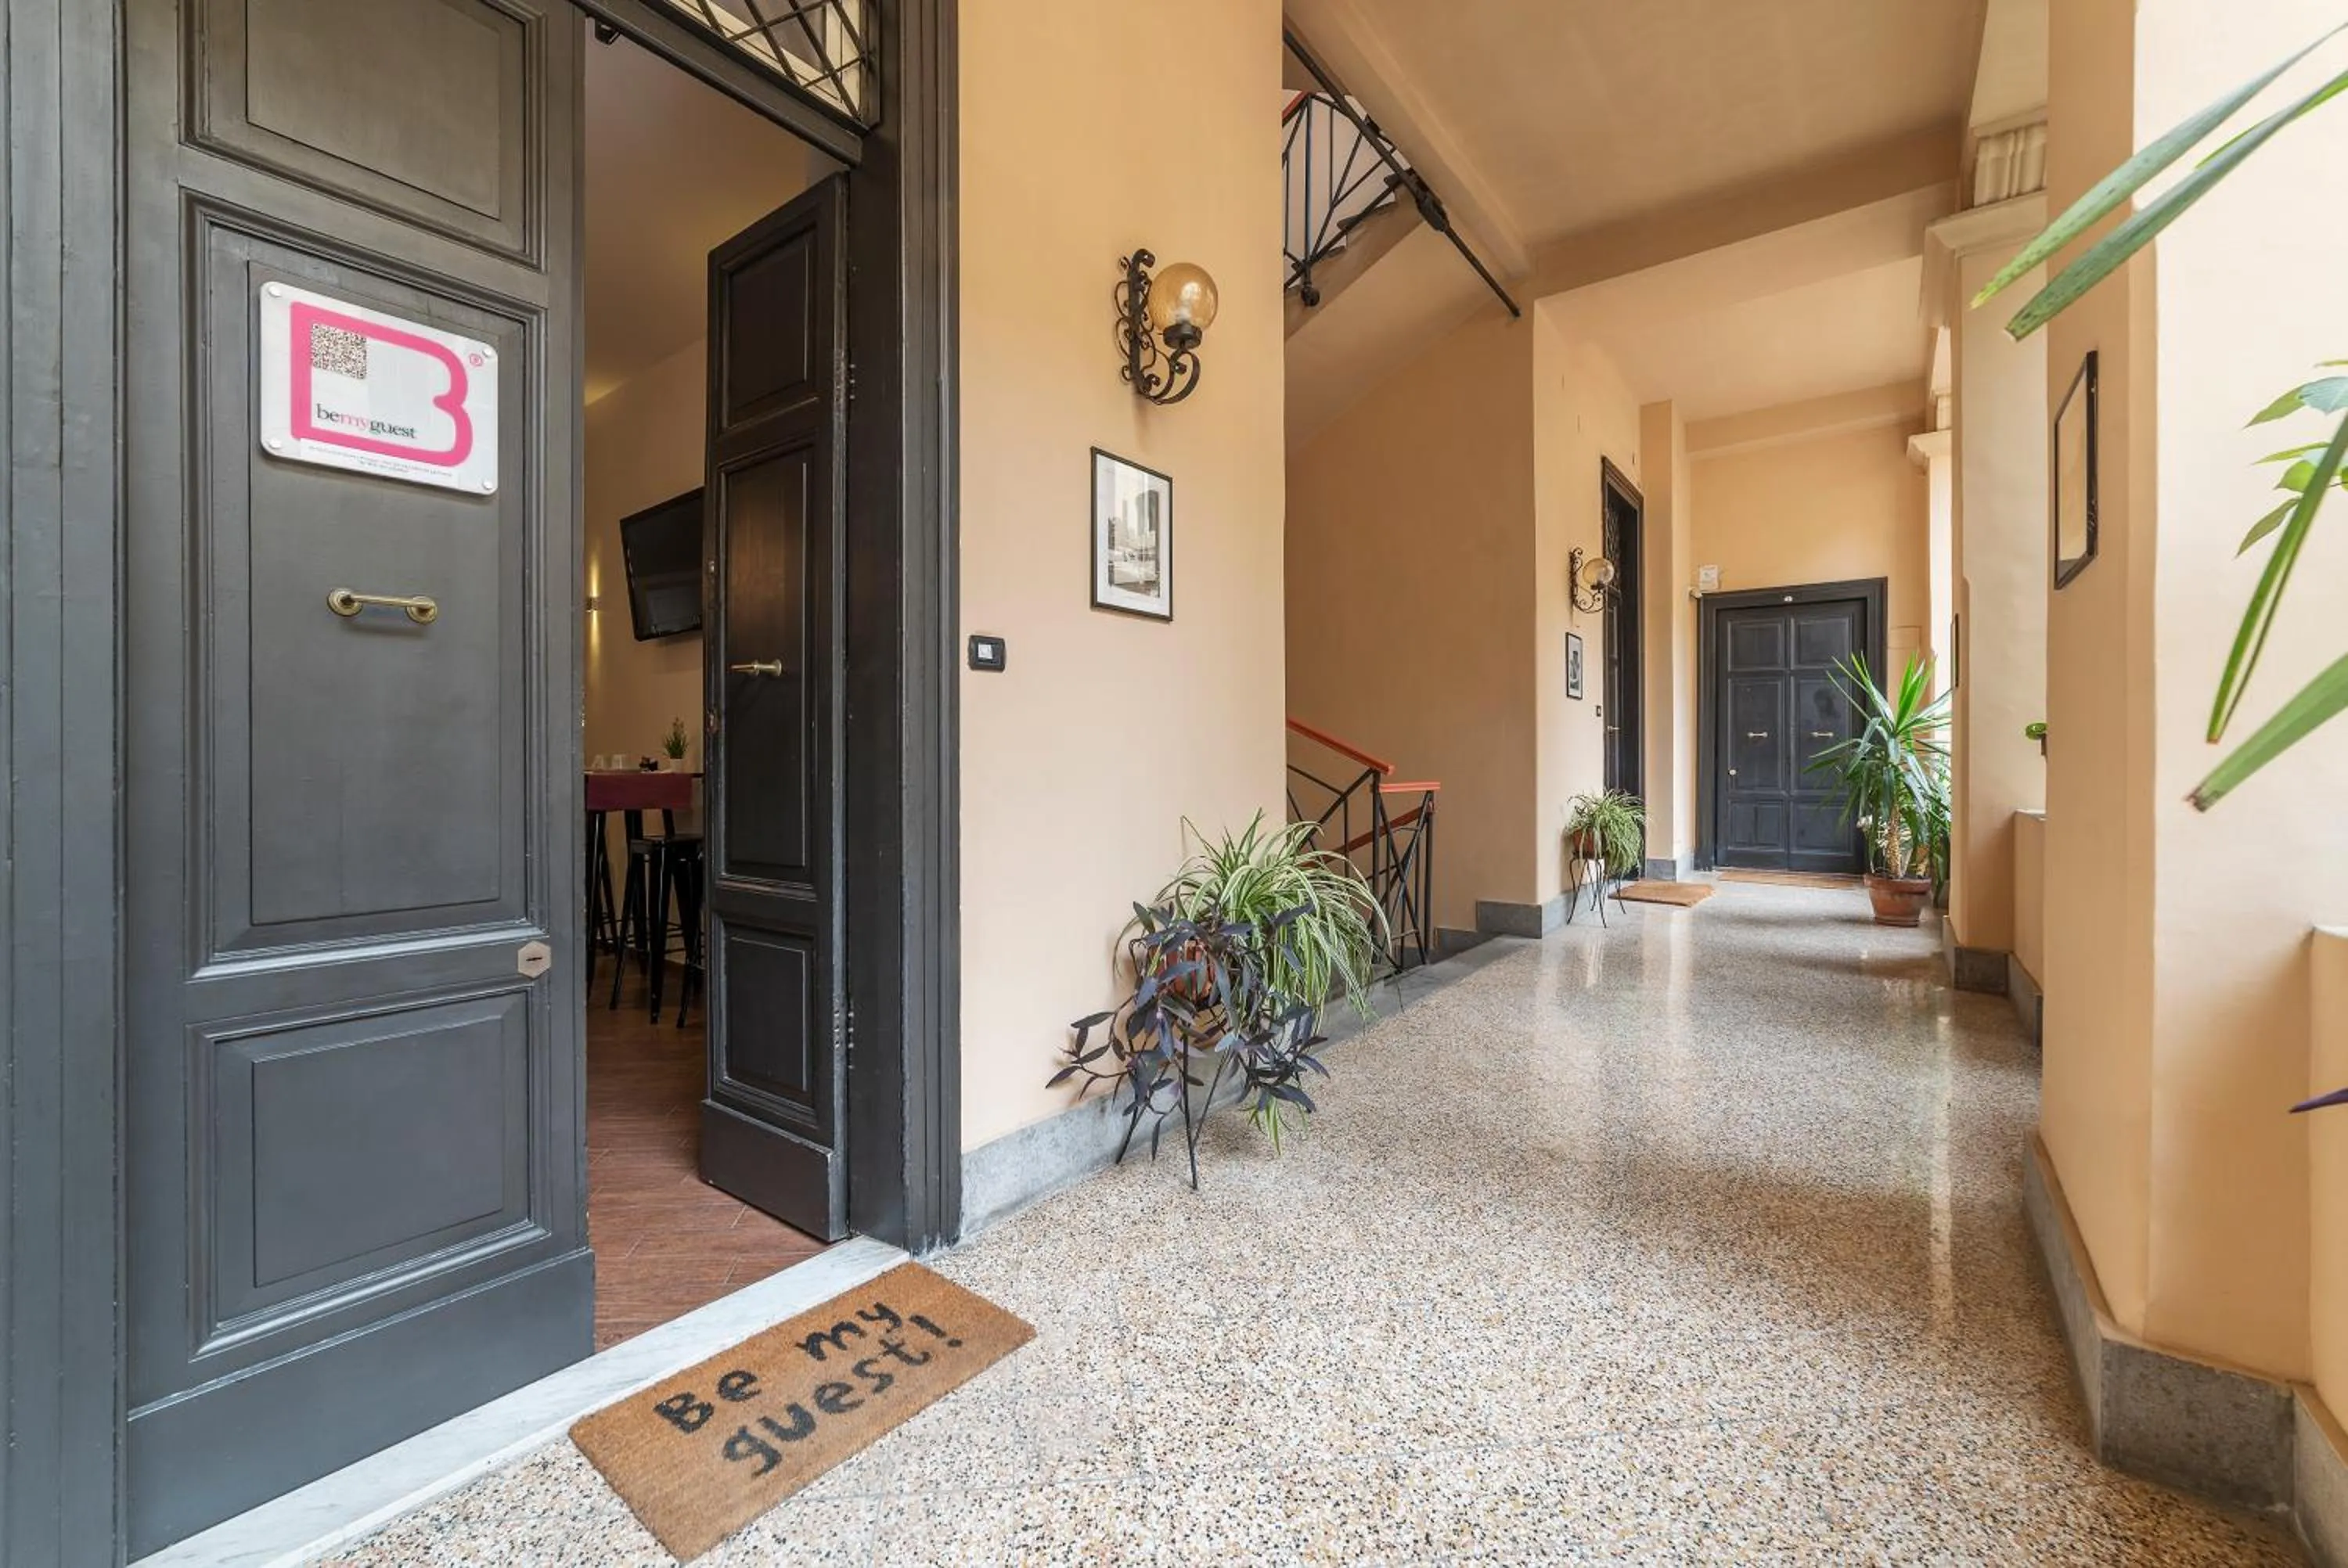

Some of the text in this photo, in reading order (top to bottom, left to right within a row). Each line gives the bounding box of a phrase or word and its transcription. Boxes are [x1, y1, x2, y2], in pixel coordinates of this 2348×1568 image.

[316, 403, 416, 439] bemyguest
[653, 1302, 902, 1433] Be my
[722, 1314, 963, 1478] guest!
